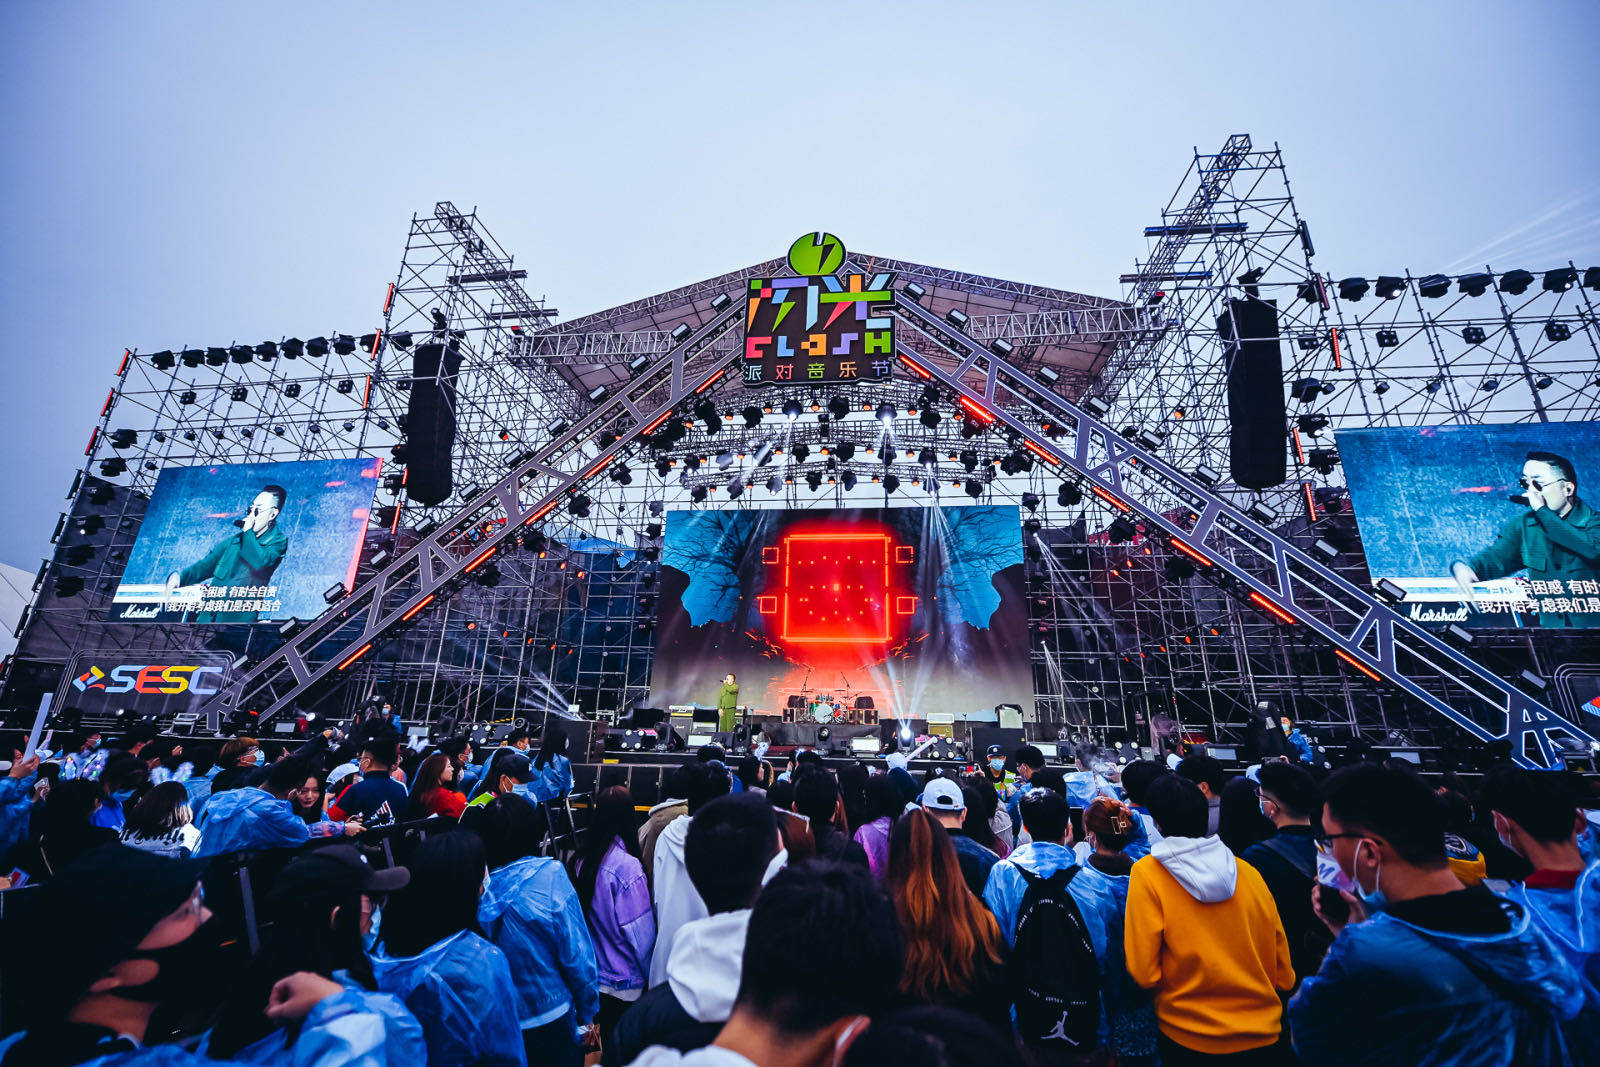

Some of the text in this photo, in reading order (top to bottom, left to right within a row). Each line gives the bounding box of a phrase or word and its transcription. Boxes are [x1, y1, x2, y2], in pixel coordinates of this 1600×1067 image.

[745, 360, 889, 380] 派对音乐节
[1566, 579, 1600, 595] 有时
[120, 604, 160, 618] Marshall
[1404, 603, 1468, 621] Marshall
[105, 665, 223, 695] SESC
